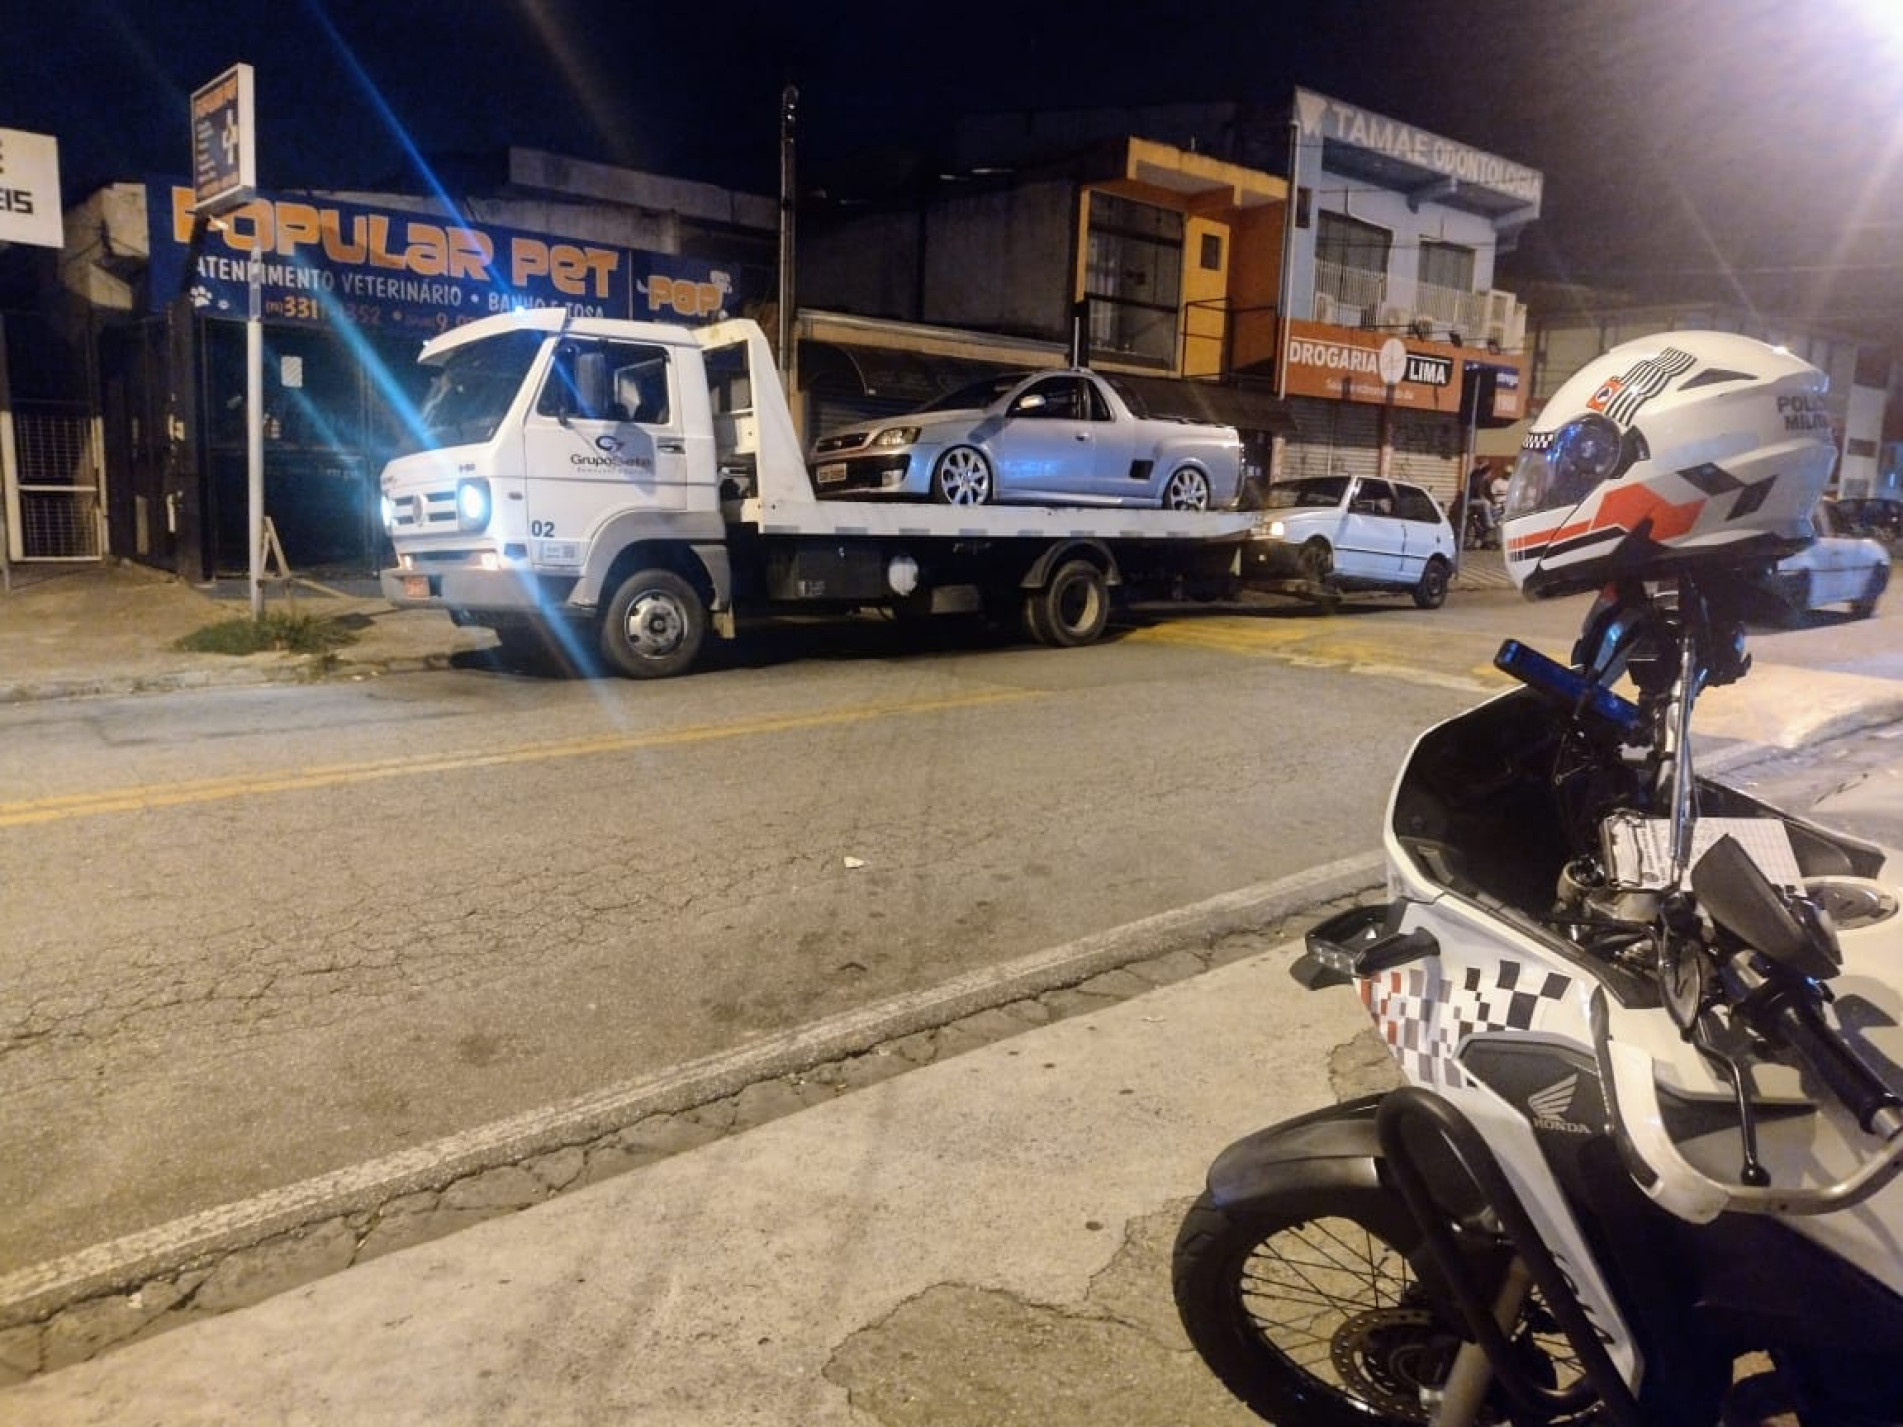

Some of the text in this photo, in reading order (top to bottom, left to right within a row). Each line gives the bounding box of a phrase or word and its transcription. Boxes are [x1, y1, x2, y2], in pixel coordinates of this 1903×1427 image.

[1332, 103, 1429, 165] TAMAE
[0, 187, 33, 214] IS
[197, 255, 462, 307] ATENIMENTO VETERINÁRIO
[647, 275, 724, 317] POP
[1289, 341, 1446, 384] DROGARIA LIMA
[531, 520, 555, 538] 02
[1533, 1117, 1592, 1134] HONDA
